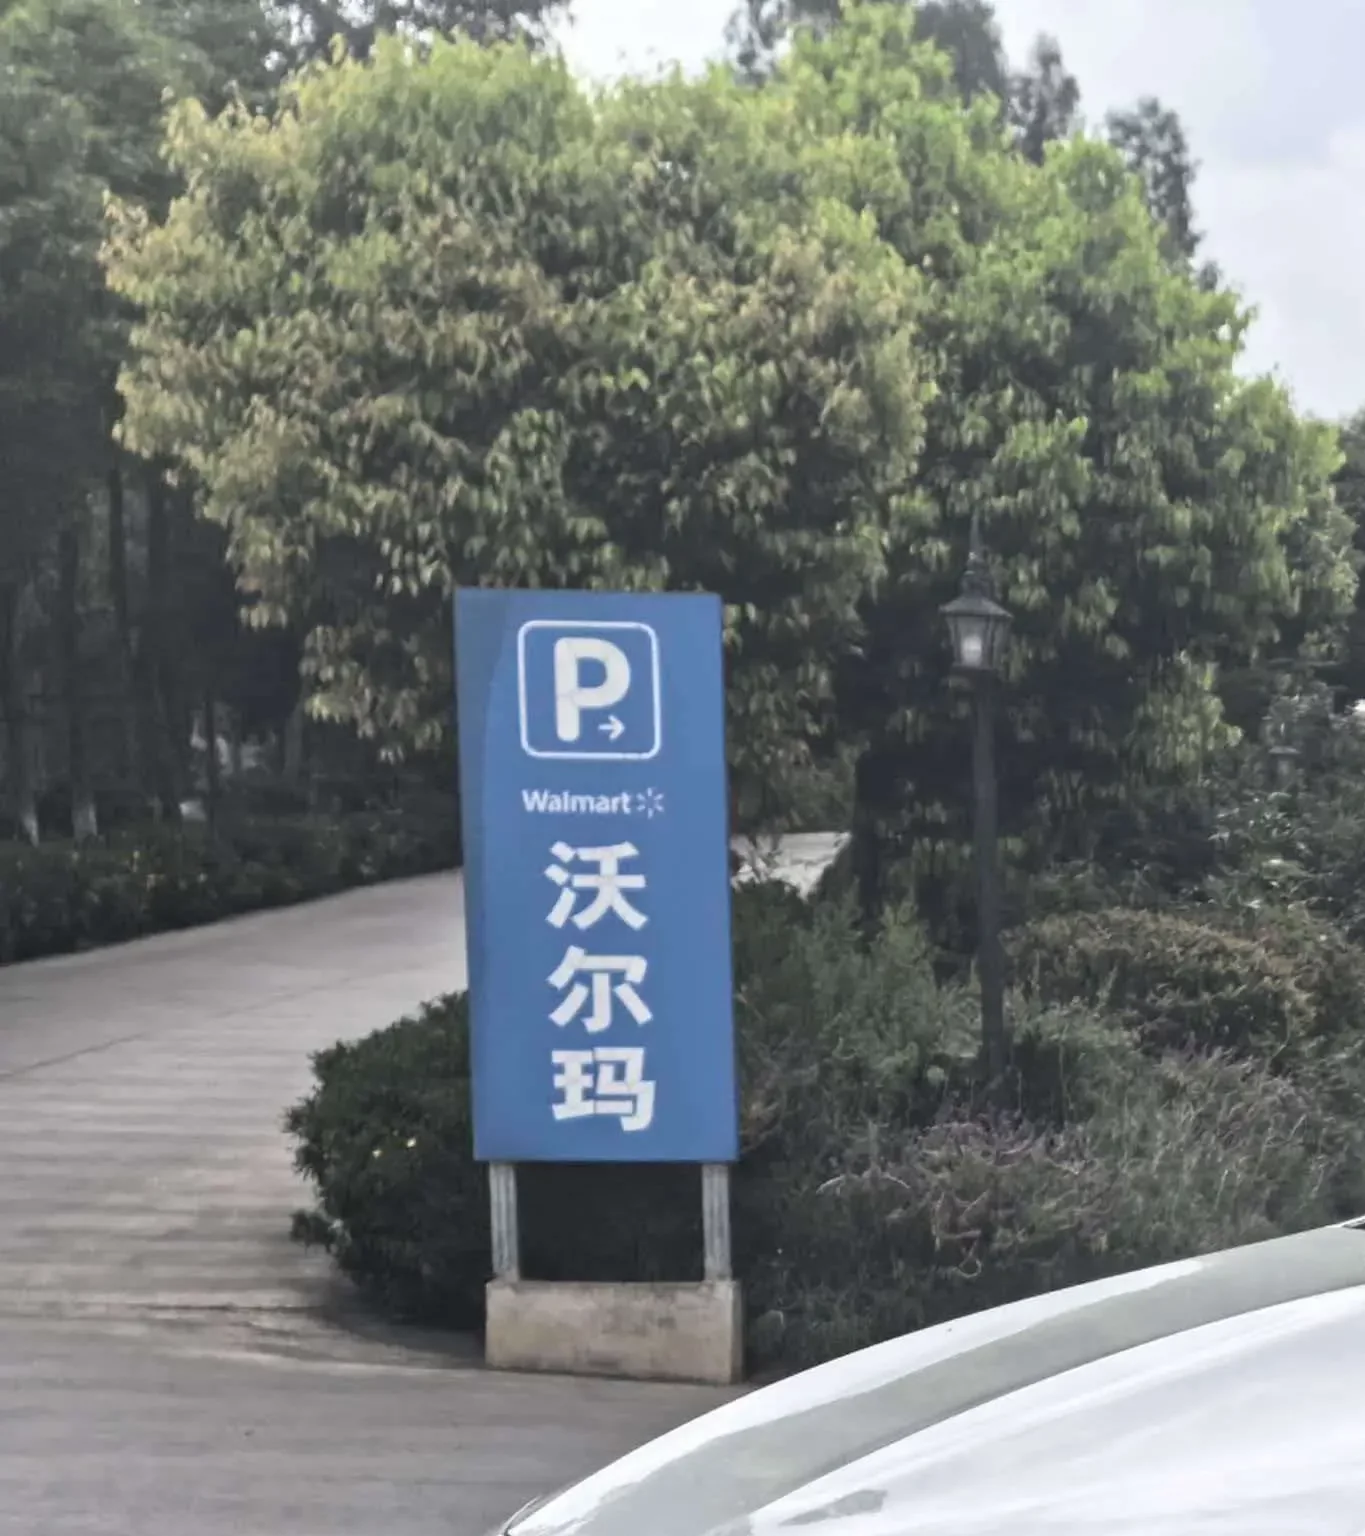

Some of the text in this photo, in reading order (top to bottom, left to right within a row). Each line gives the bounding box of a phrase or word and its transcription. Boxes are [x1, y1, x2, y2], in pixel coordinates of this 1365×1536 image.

[553, 637, 631, 742] P
[522, 789, 632, 814] Walmart
[543, 840, 656, 1132] 沃尔玛
